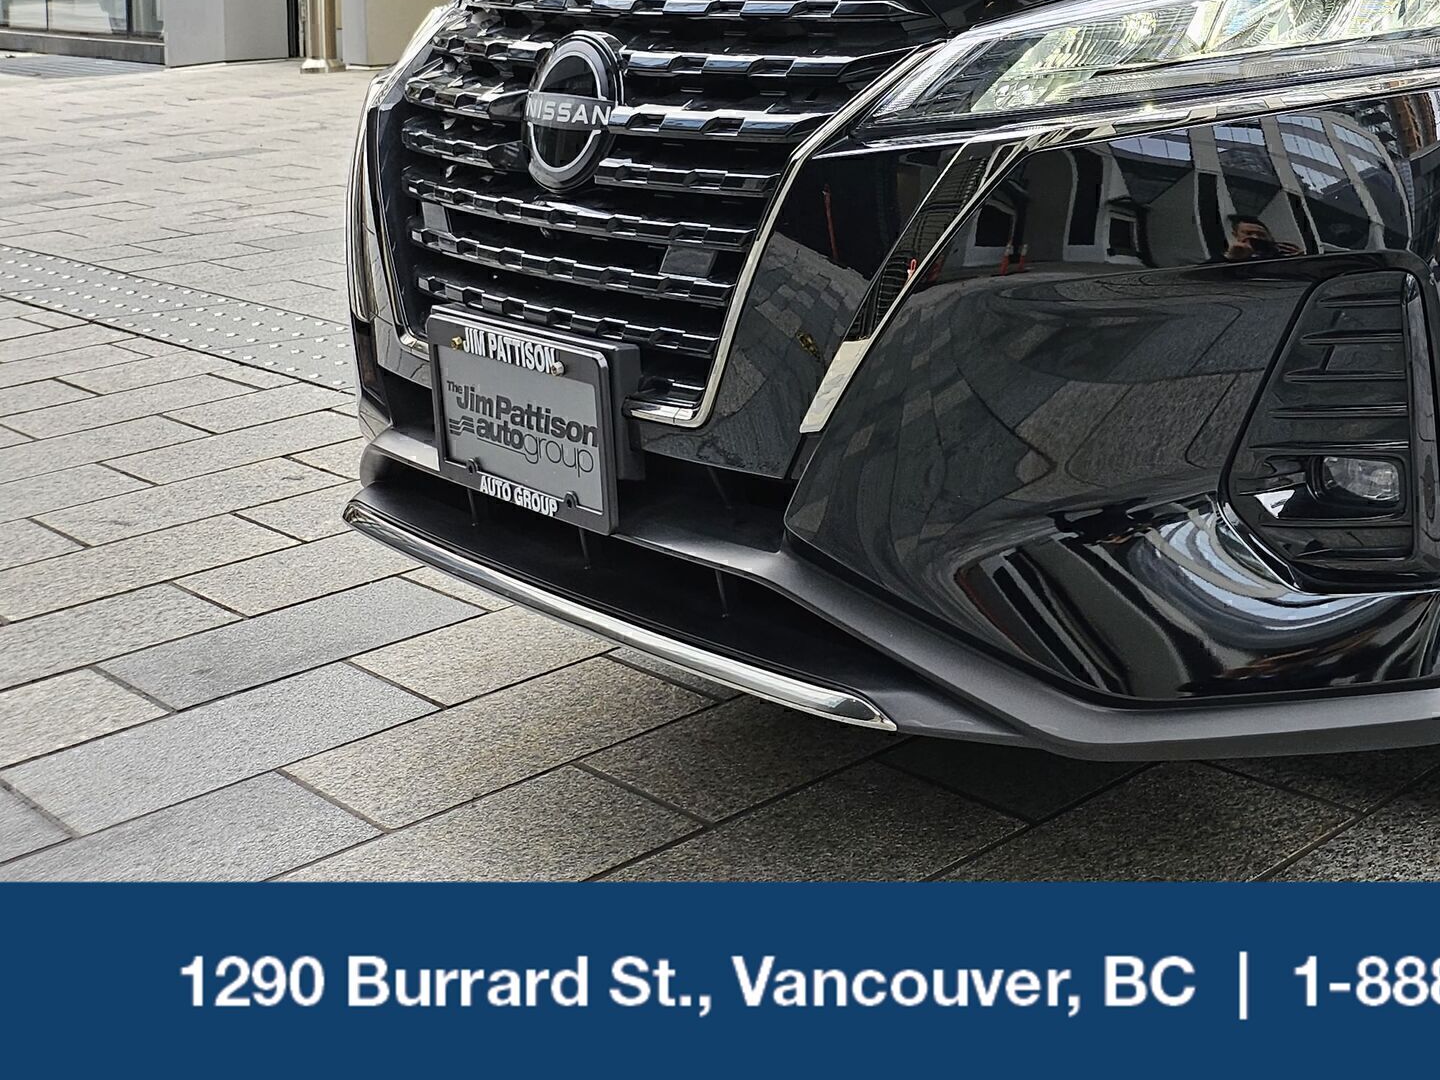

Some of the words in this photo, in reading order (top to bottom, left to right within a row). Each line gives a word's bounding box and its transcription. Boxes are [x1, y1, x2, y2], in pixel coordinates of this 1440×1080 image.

[525, 98, 612, 126] NISSAN
[462, 327, 487, 358] JIM
[488, 332, 556, 374] PATTISON
[447, 380, 463, 395] The
[479, 475, 512, 502] AUTO
[513, 487, 558, 517] GROUP
